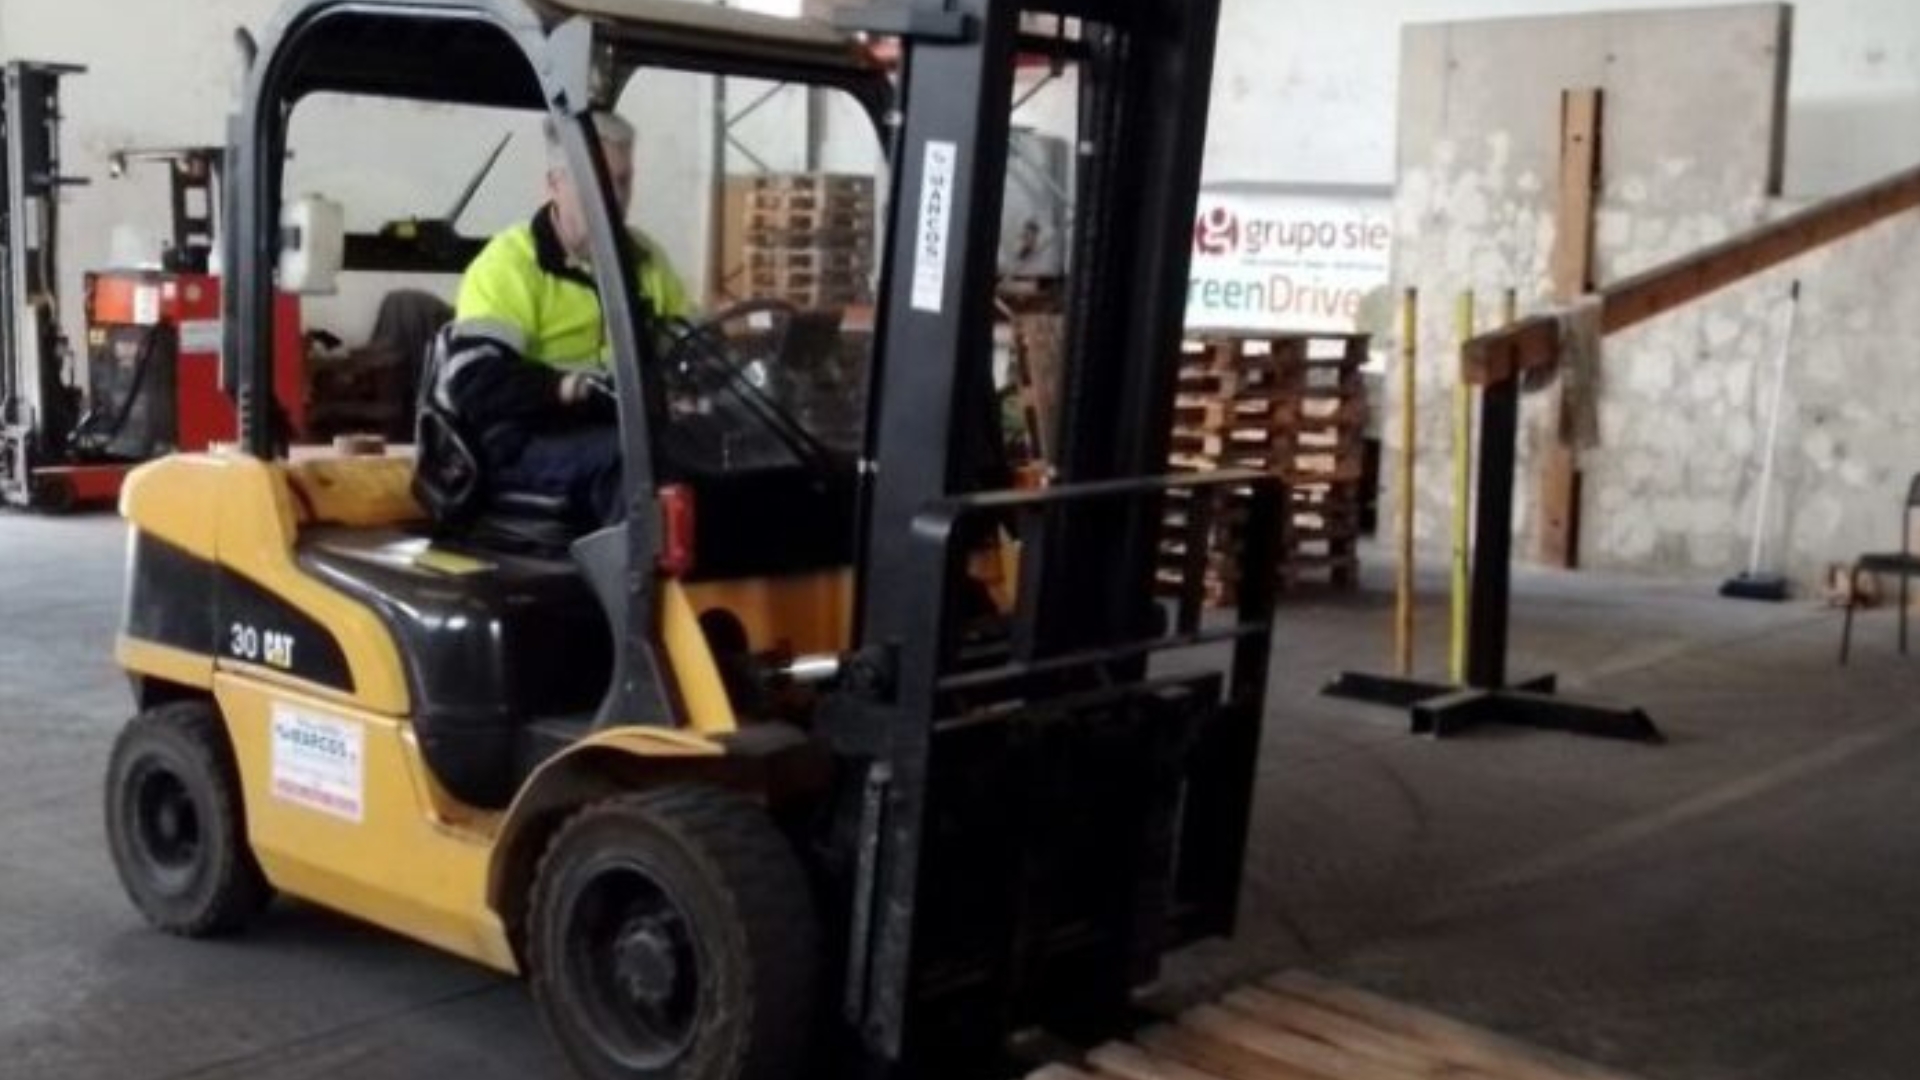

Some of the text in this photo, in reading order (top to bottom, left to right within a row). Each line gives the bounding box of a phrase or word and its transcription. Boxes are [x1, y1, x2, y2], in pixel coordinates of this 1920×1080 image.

[1246, 219, 1337, 255] grupo
[1343, 219, 1389, 252] sie
[1188, 273, 1363, 318] reenDrive
[230, 622, 294, 668] 30 CAT
